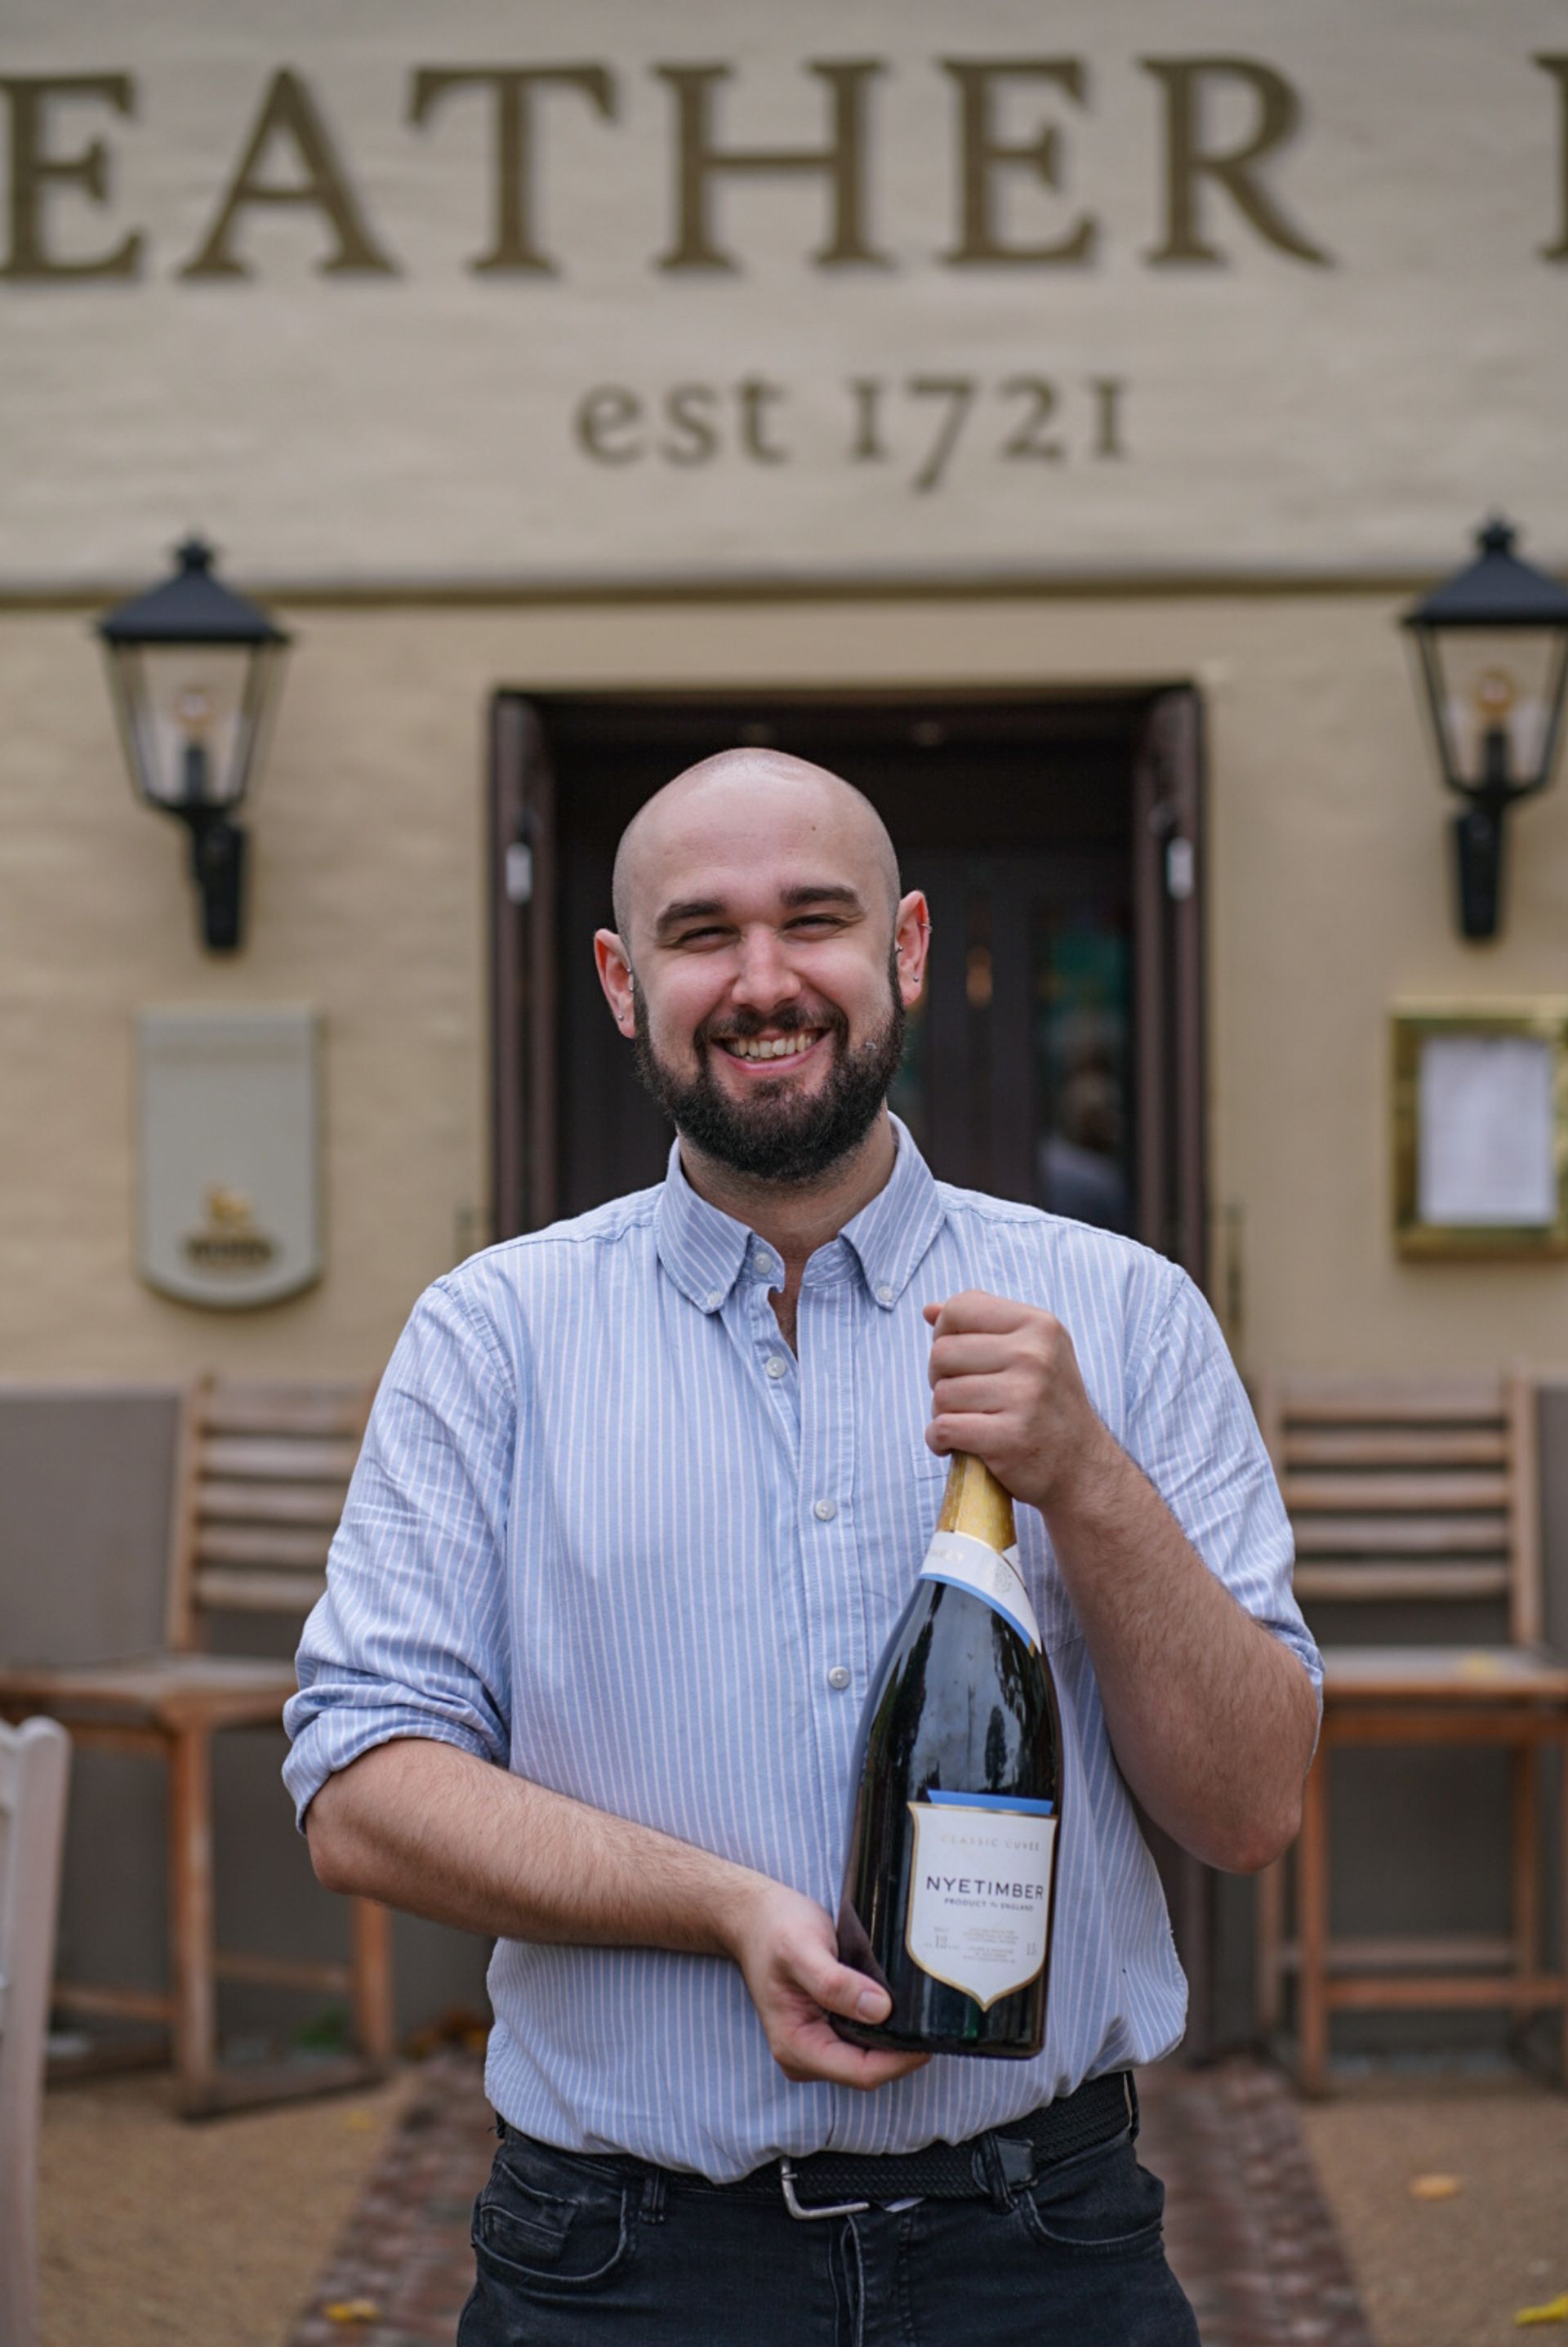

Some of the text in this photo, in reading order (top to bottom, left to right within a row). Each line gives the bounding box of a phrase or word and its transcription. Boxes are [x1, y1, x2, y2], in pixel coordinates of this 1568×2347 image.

[0, 56, 1334, 281] EATHER
[575, 371, 1125, 493] est 1721
[941, 1834, 999, 1847] CLASSIC
[926, 1875, 1045, 1900] NYETIMBER
[944, 1898, 987, 1907] PRODUCT
[1000, 1903, 1034, 1912] ENGLAND
